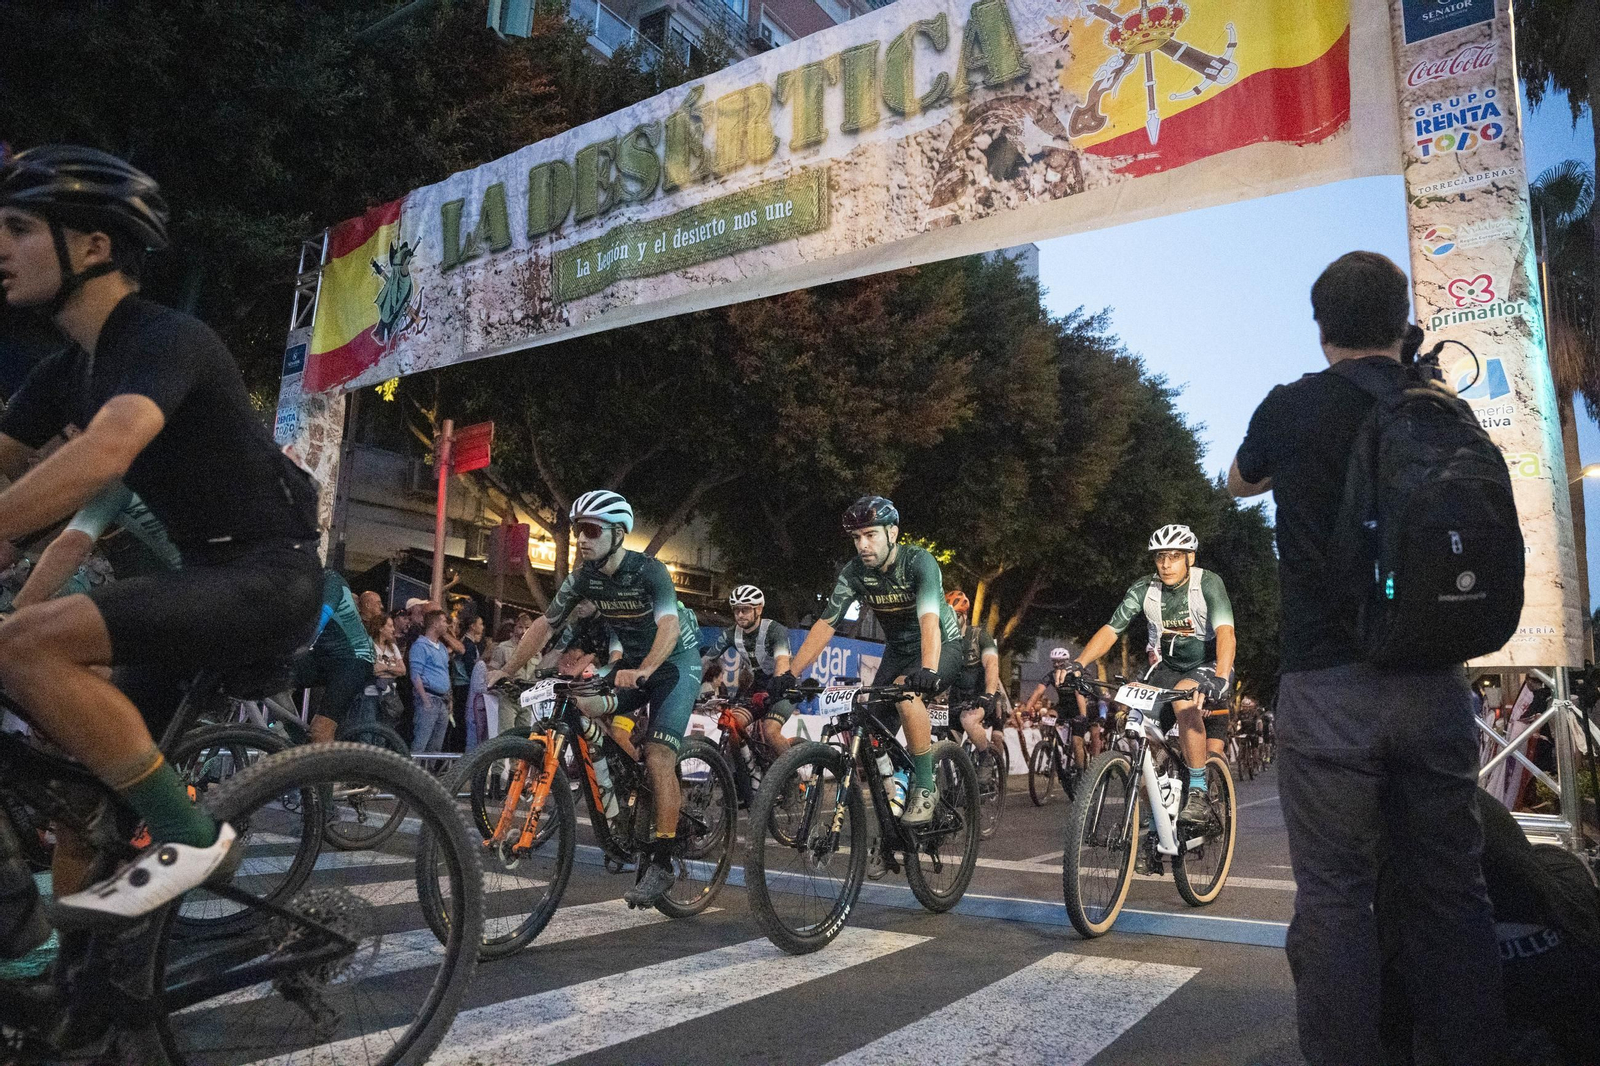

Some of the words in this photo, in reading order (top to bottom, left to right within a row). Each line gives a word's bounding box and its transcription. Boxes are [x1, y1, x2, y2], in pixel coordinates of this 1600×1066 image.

[1422, 0, 1473, 20] SENATOR
[1407, 42, 1498, 87] Coca-Cola
[1414, 89, 1497, 117] GRUPO
[1415, 101, 1502, 137] RENTA
[441, 181, 512, 273] LA
[527, 0, 1032, 239] DESÉRTICA
[1416, 122, 1504, 157] TODO
[576, 258, 591, 278] La
[596, 242, 629, 272] Legión
[637, 241, 648, 262] y
[654, 232, 667, 254] el
[673, 218, 726, 249] desierto
[733, 208, 758, 231] nos
[765, 199, 793, 221] une
[1431, 302, 1525, 331] primaflor
[277, 413, 296, 425] RENTA
[1473, 404, 1514, 418] mería
[1480, 417, 1511, 428] tiva
[1515, 626, 1556, 635] MERÍA
[825, 690, 855, 704] 6046
[1125, 686, 1156, 701] 7192
[929, 710, 947, 720] 5266
[653, 730, 664, 740] LA
